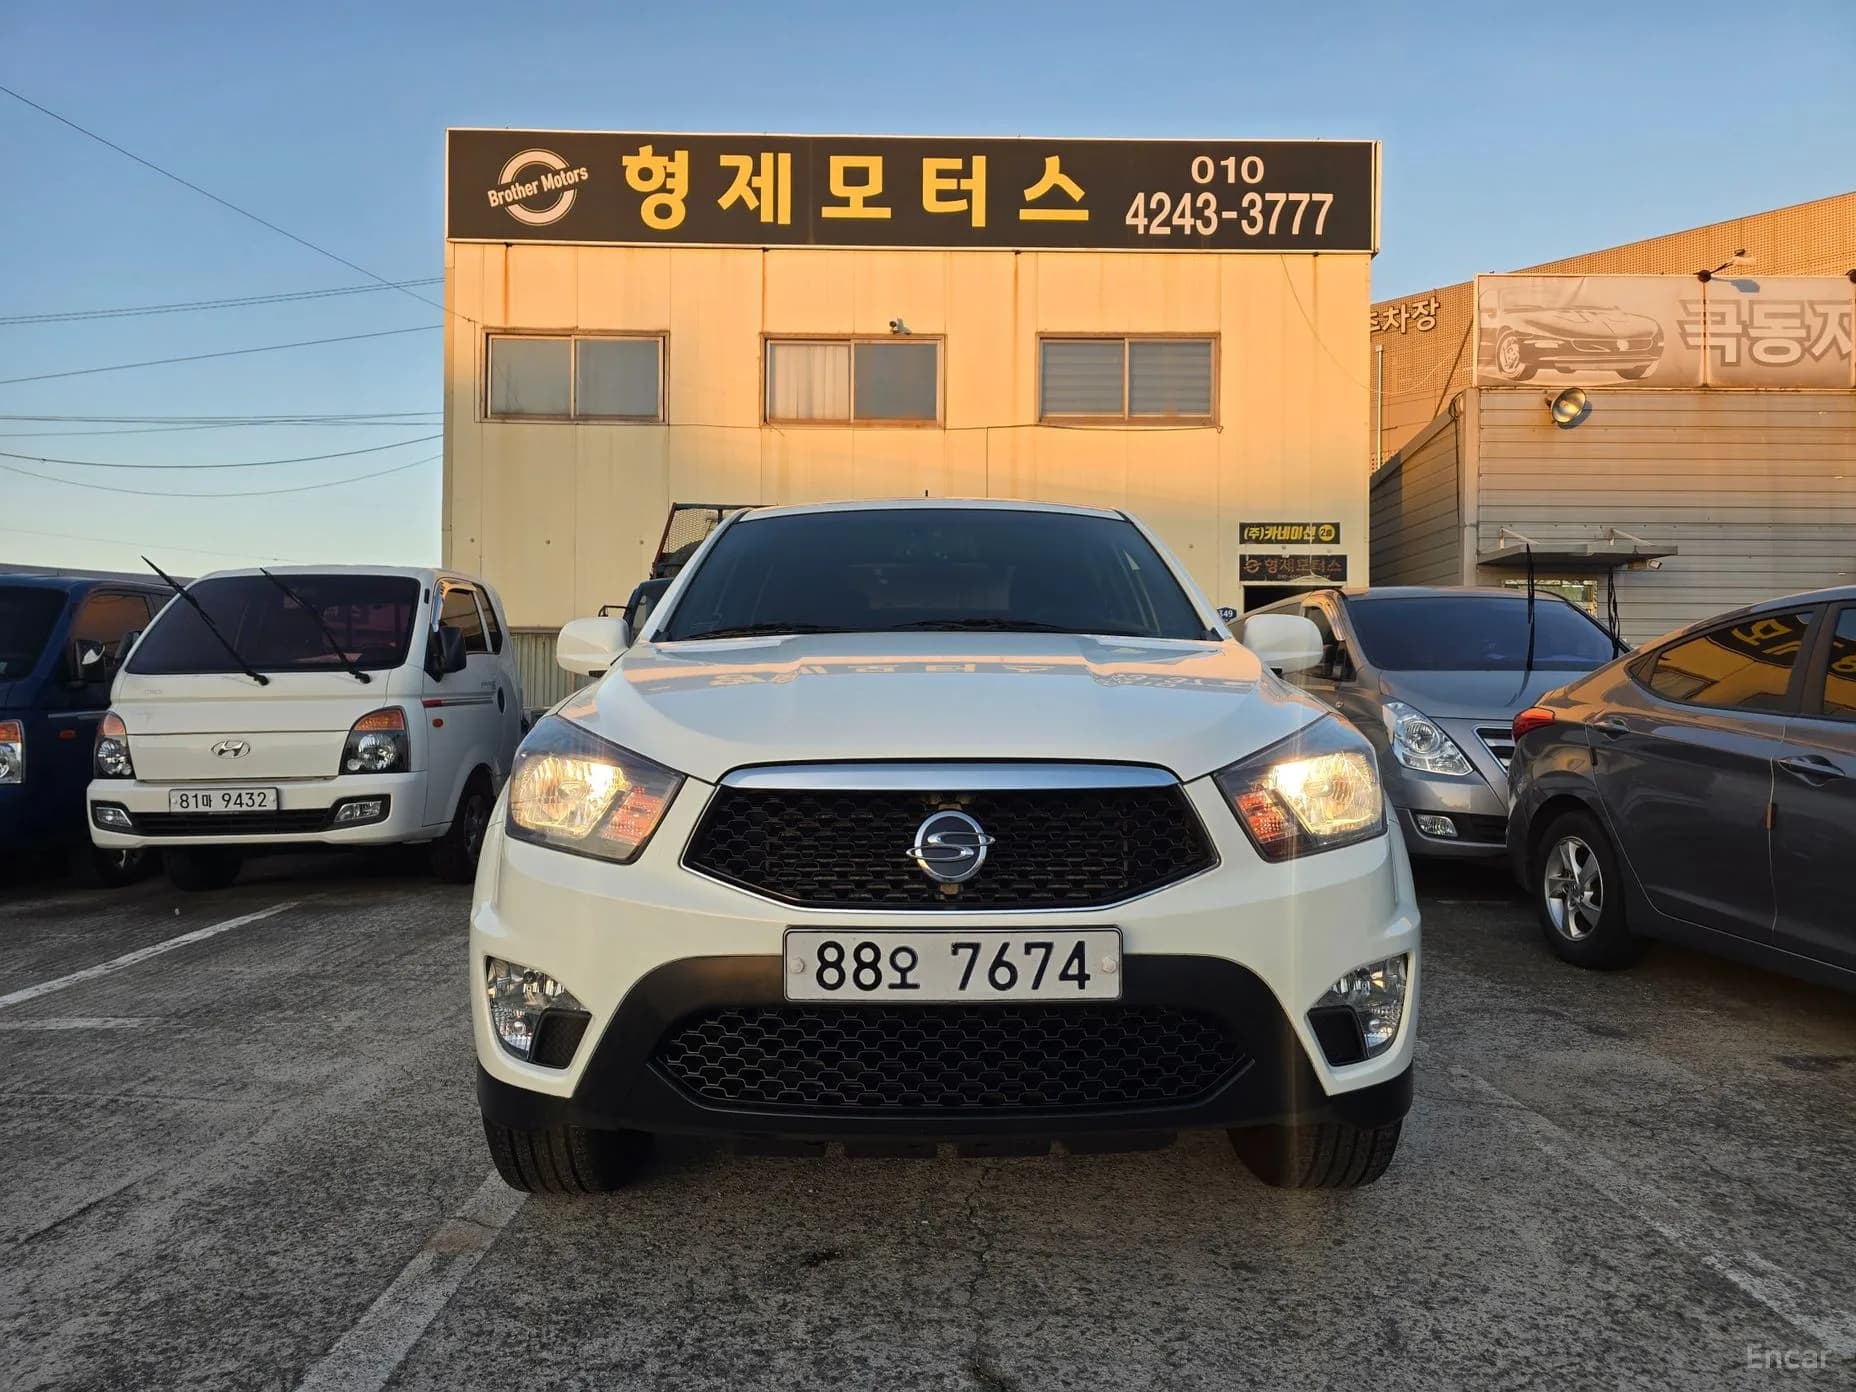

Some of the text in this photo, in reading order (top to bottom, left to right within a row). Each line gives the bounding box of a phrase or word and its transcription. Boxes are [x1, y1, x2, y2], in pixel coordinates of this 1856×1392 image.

[487, 167, 589, 208] Brother Motors
[622, 144, 1089, 230] 형제모터스
[1191, 156, 1265, 184] 010
[1125, 192, 1334, 236] 4243-3777
[179, 792, 267, 809] 81마 9432
[816, 941, 1091, 991] 88오 7674
